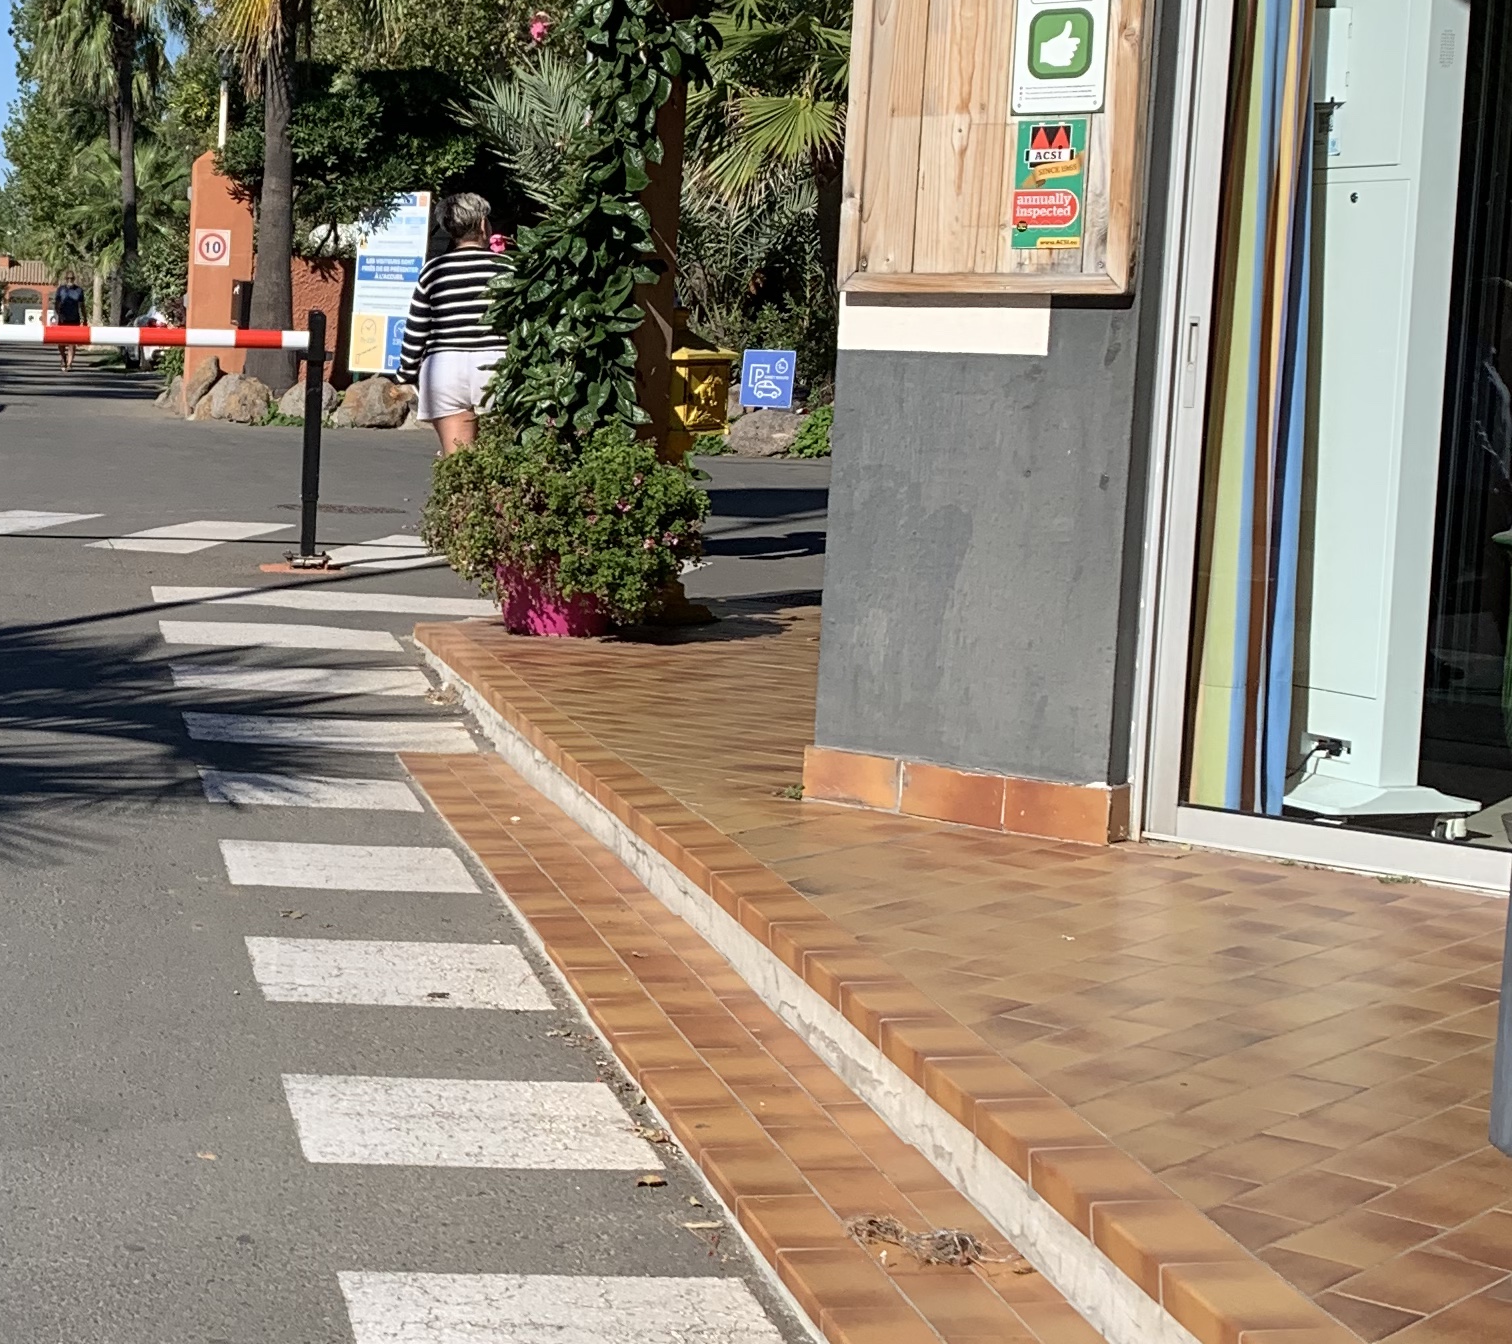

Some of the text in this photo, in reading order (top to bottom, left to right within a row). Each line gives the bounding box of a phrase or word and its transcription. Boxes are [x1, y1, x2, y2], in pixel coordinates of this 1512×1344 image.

[1034, 150, 1063, 161] ACSI
[1038, 166, 1061, 176] SINCE
[1016, 193, 1072, 206] annually
[1015, 206, 1072, 219] inspected
[205, 241, 221, 254] 10
[755, 369, 764, 382] P
